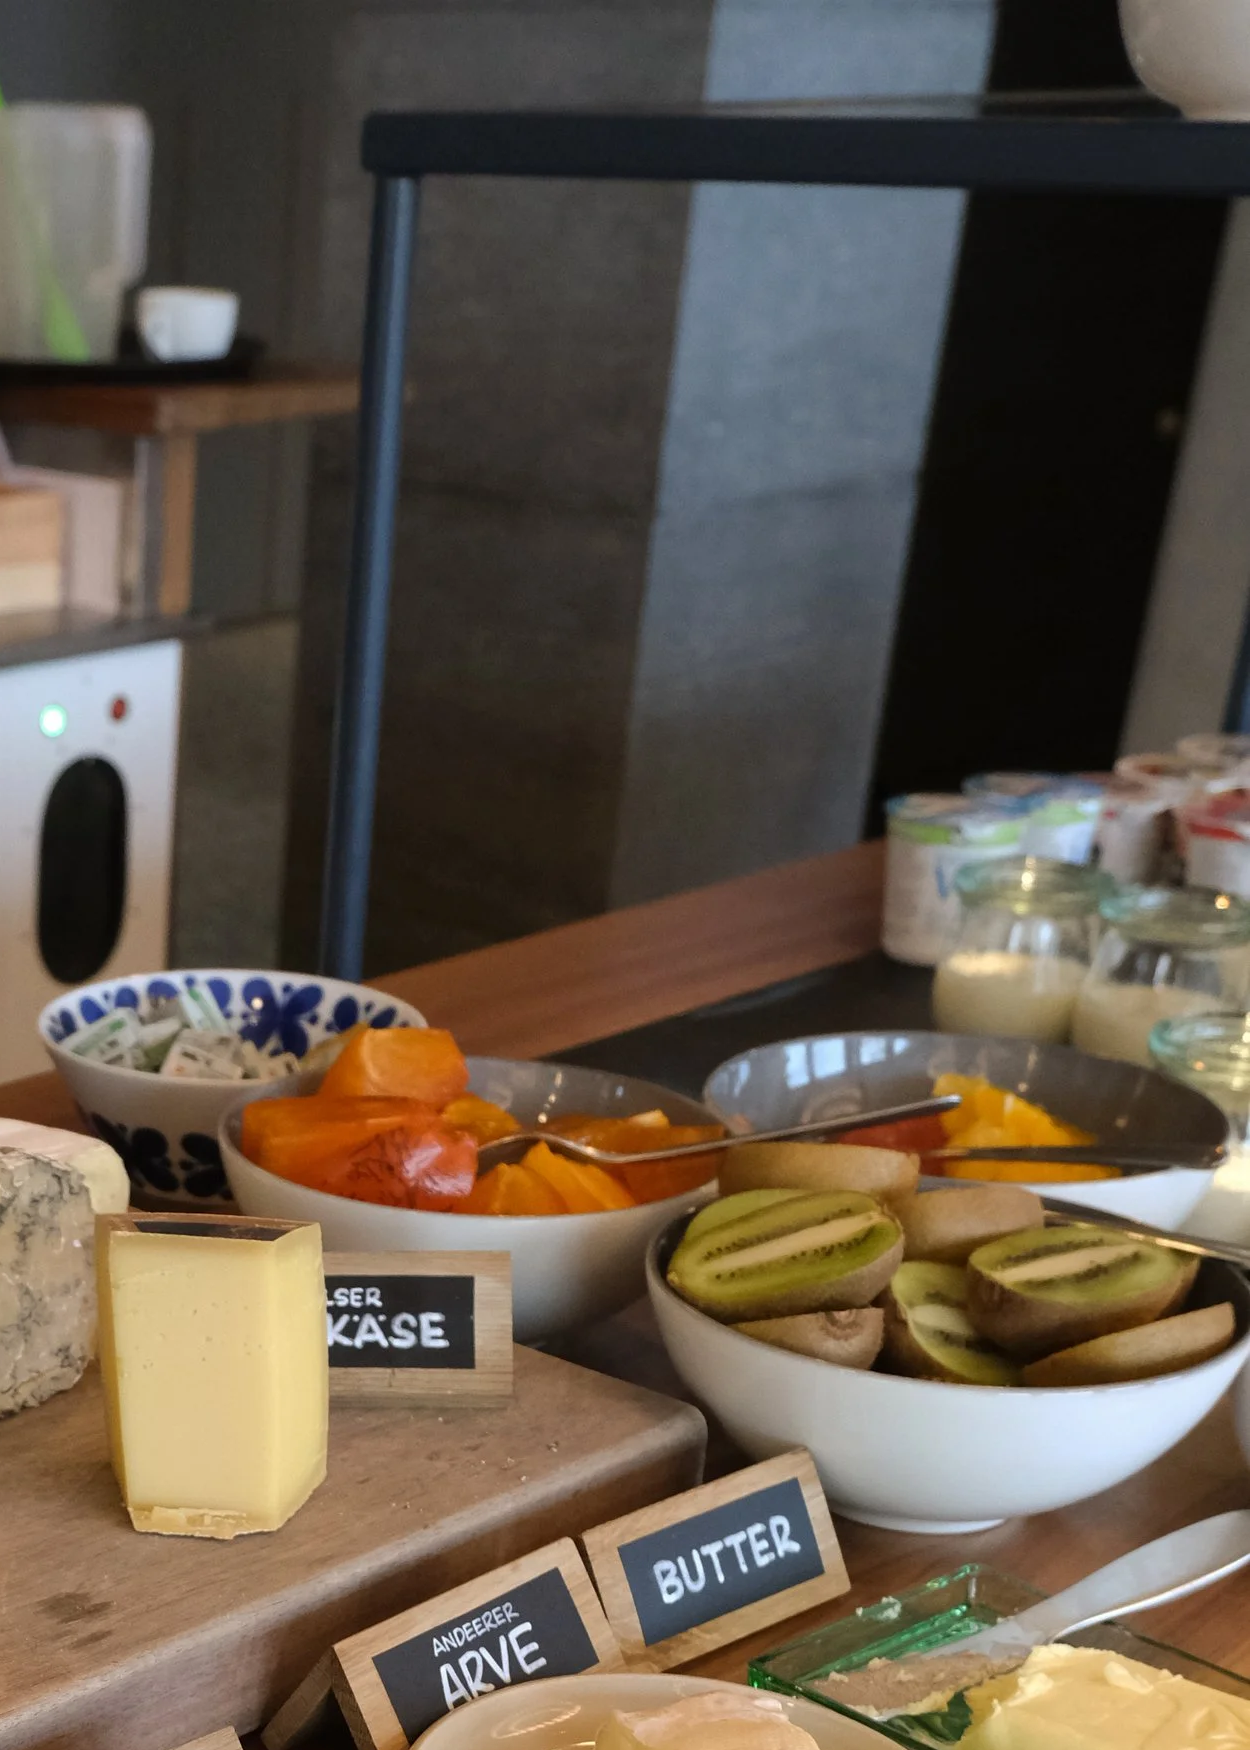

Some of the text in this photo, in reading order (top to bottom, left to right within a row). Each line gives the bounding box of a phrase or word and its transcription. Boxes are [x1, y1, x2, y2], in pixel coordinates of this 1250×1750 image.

[326, 1311, 450, 1349] KÄSE
[653, 1514, 801, 1604] BUTTER
[432, 1602, 519, 1657] ANDEERER
[440, 1621, 547, 1710] ARVE
